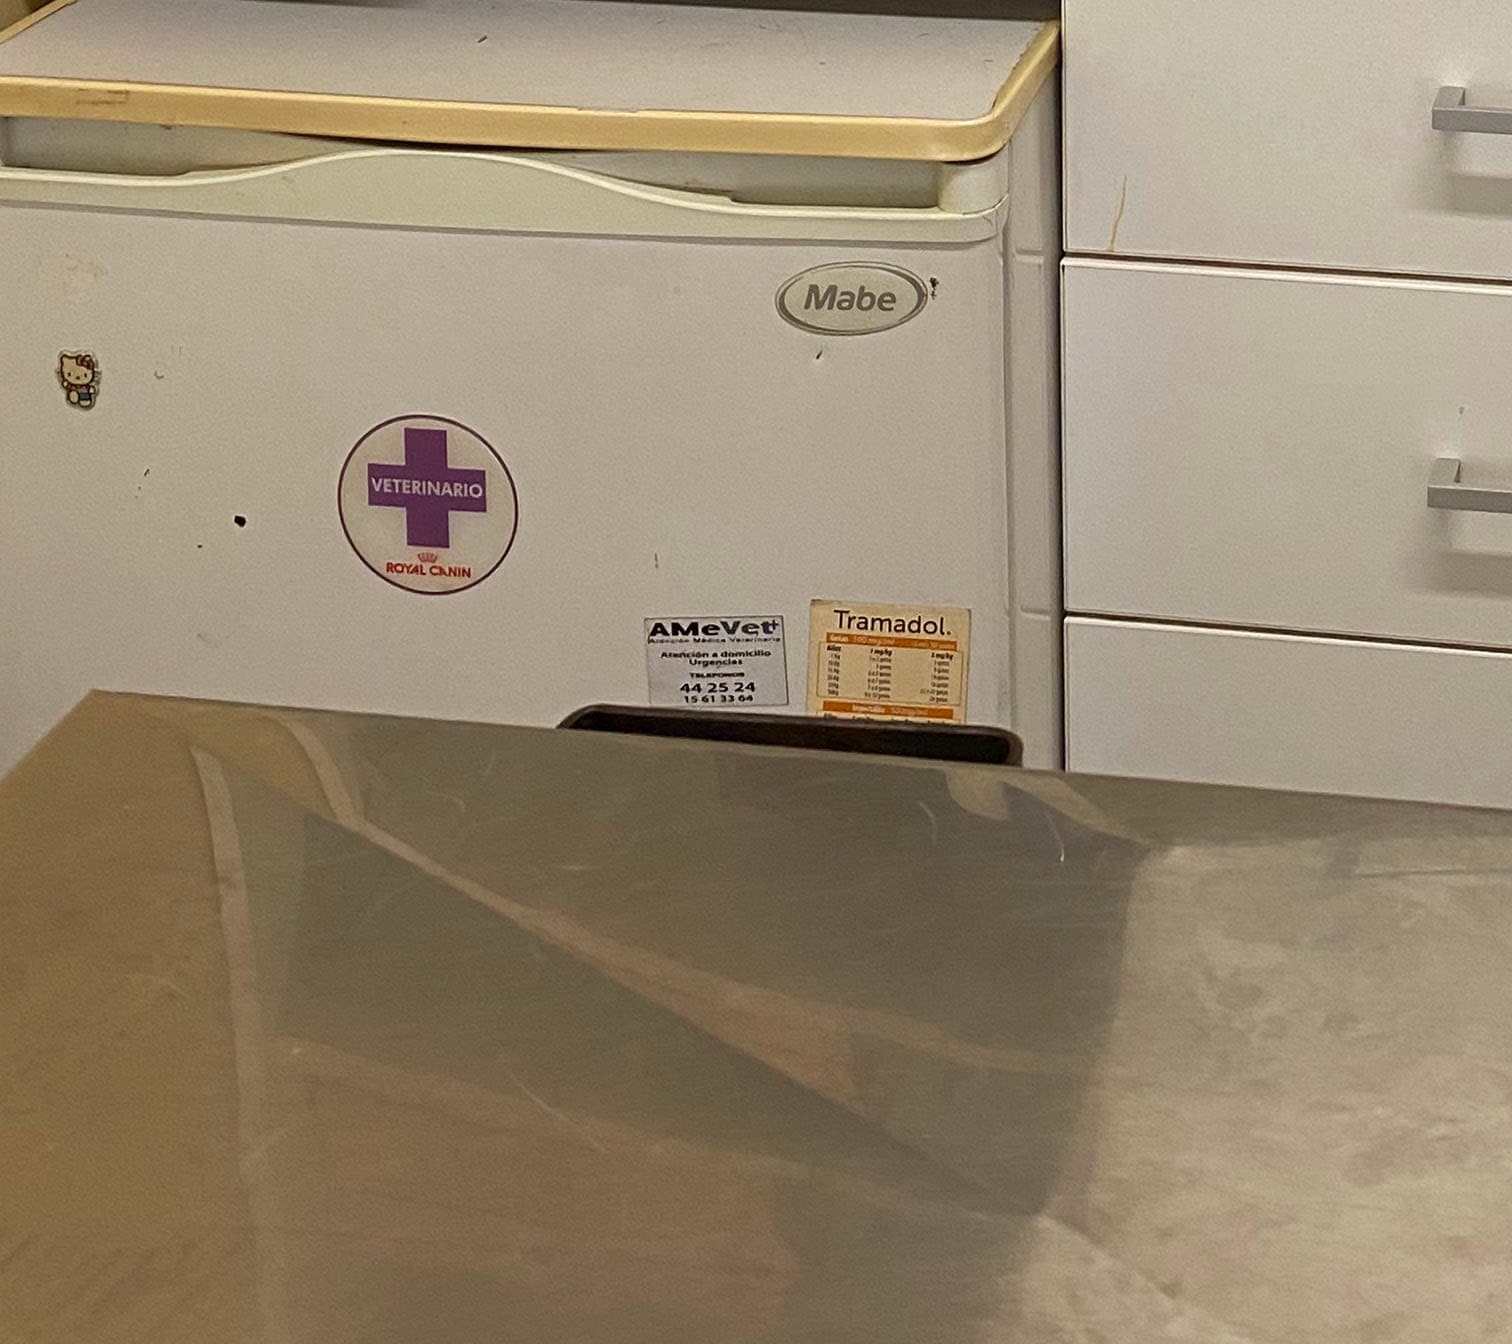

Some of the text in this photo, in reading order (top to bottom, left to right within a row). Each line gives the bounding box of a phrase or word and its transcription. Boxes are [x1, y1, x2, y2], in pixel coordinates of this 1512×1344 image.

[803, 283, 897, 311] Mabe
[371, 477, 483, 498] VETERINARIO
[386, 562, 472, 578] ROYAL CANIN
[689, 658, 743, 668] Urgencias
[680, 682, 756, 693] 44 25 24
[684, 695, 698, 703] 15
[701, 695, 715, 703] 61
